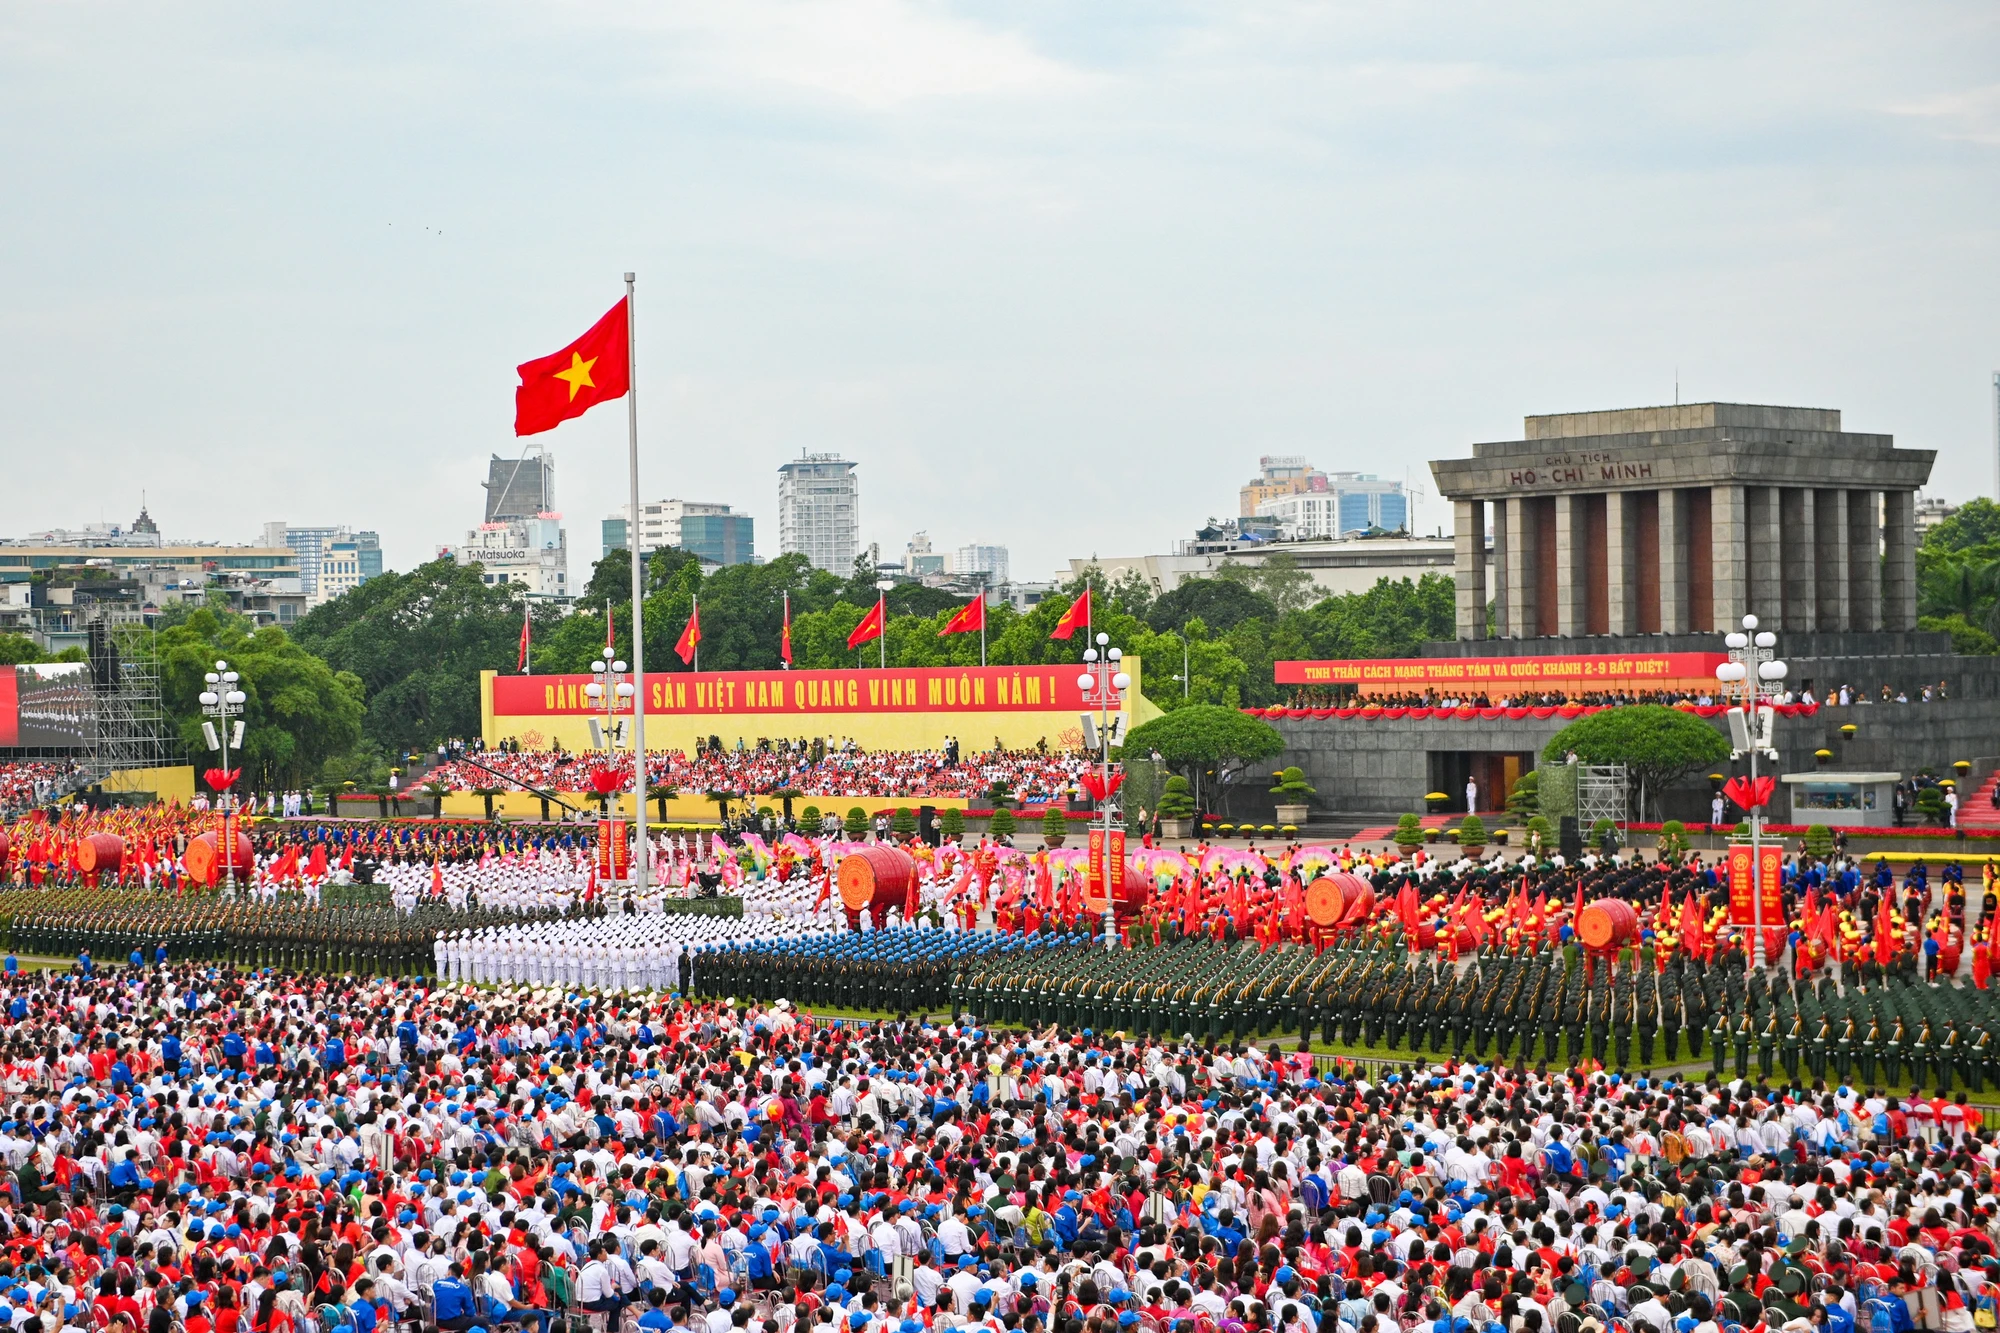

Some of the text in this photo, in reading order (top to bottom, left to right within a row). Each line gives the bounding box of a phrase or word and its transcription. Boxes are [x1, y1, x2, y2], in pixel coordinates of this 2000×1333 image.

[1304, 667, 1330, 679] TINH
[1333, 663, 1361, 678] THẦN
[1364, 664, 1391, 678] CÁCH
[1394, 665, 1425, 680] MẠNG
[1427, 663, 1464, 677] THÁNG
[1466, 663, 1491, 677] TÁM
[1493, 660, 1508, 676] VÀ
[1510, 659, 1540, 677] QUỐC
[1542, 660, 1582, 675] KHÁNH
[1584, 661, 1606, 675] 2-9
[1609, 658, 1633, 674] BẤT
[545, 678, 588, 710] ĐẢNG
[653, 676, 686, 709] SẢN
[695, 677, 735, 712] VIỆT
[745, 680, 784, 707] NAM
[794, 678, 858, 710] QUANG
[868, 678, 917, 706] VINH
[928, 672, 985, 705] MUÔN
[997, 671, 1041, 705] NĂM
